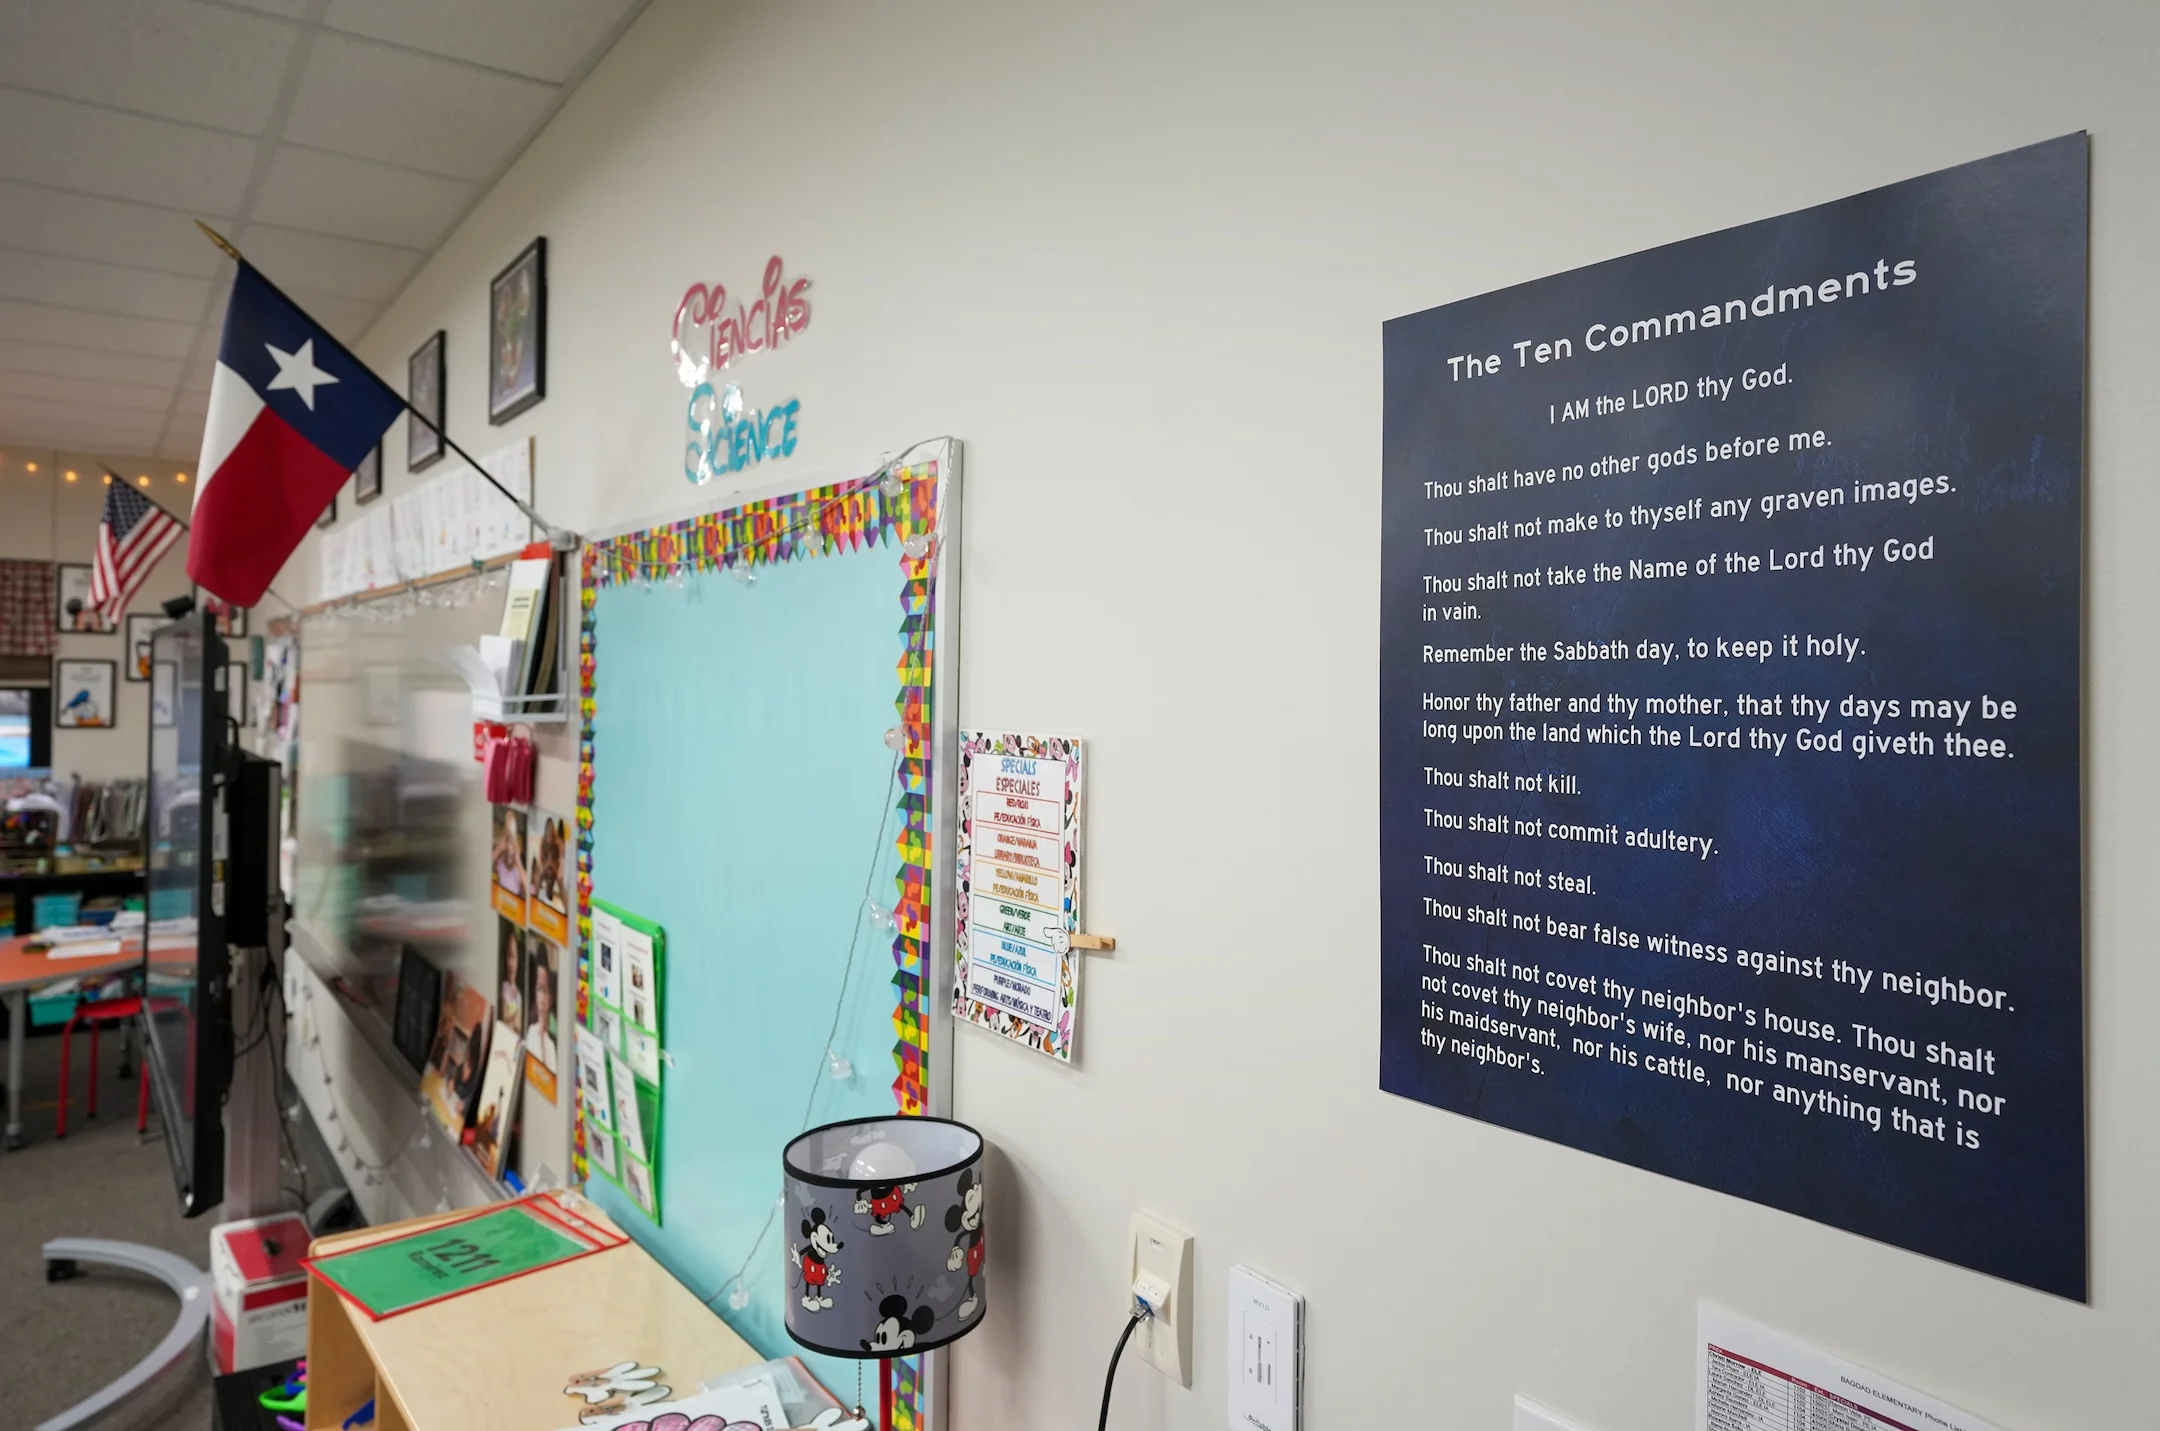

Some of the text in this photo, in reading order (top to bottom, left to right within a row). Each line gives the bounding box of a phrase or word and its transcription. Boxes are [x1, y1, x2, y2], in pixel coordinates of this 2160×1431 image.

[1446, 258, 1917, 382] The Ten Commandments
[1550, 362, 1793, 425] I AM the LORD thy God.
[1423, 430, 1832, 500] Thou shalt have no other gods before me.
[1423, 475, 1957, 547] Thou shalt not make to thyself any graven images.
[1422, 535, 1934, 594] Thou shalt not take the Name of the Lord thy God
[1422, 601, 1482, 622] in vain.
[1423, 632, 1866, 666] Remember the Sabbath day, to keep it holy.
[1422, 692, 2017, 727] Honor thy father and thy mother, that thy days may be
[1423, 719, 2014, 760] long upon the land which the Lord thy God giveth thee.
[996, 777, 1040, 796] ESPECIALES
[1001, 758, 1037, 775] SPECIALS
[1423, 766, 1581, 795] Thou shalt not kill.
[1423, 808, 1719, 861] Thou shalt not commit adultery.
[1423, 855, 1596, 896] Thou shalt not steal.
[1422, 896, 2015, 1012] Thou shalt not bear false witness against thy neighbor.
[1422, 943, 1996, 1076] Thou shalt not covet thy neighbor's house. Thou shalt
[1420, 1027, 1545, 1076] thy neighbor's.
[1421, 975, 2007, 1116] not covet thy neighbor's wife, nor his manservant, nor
[1421, 999, 1980, 1150] his maidservant, nor his cattle, nor anything that is
[427, 1239, 500, 1274] 1211
[1829, 1393, 1859, 1410] SPECIALS
[1840, 1376, 1871, 1394] BAGDAD
[1872, 1389, 1923, 1416] ELEMENTARY
[1925, 1412, 1948, 1427] Phone
